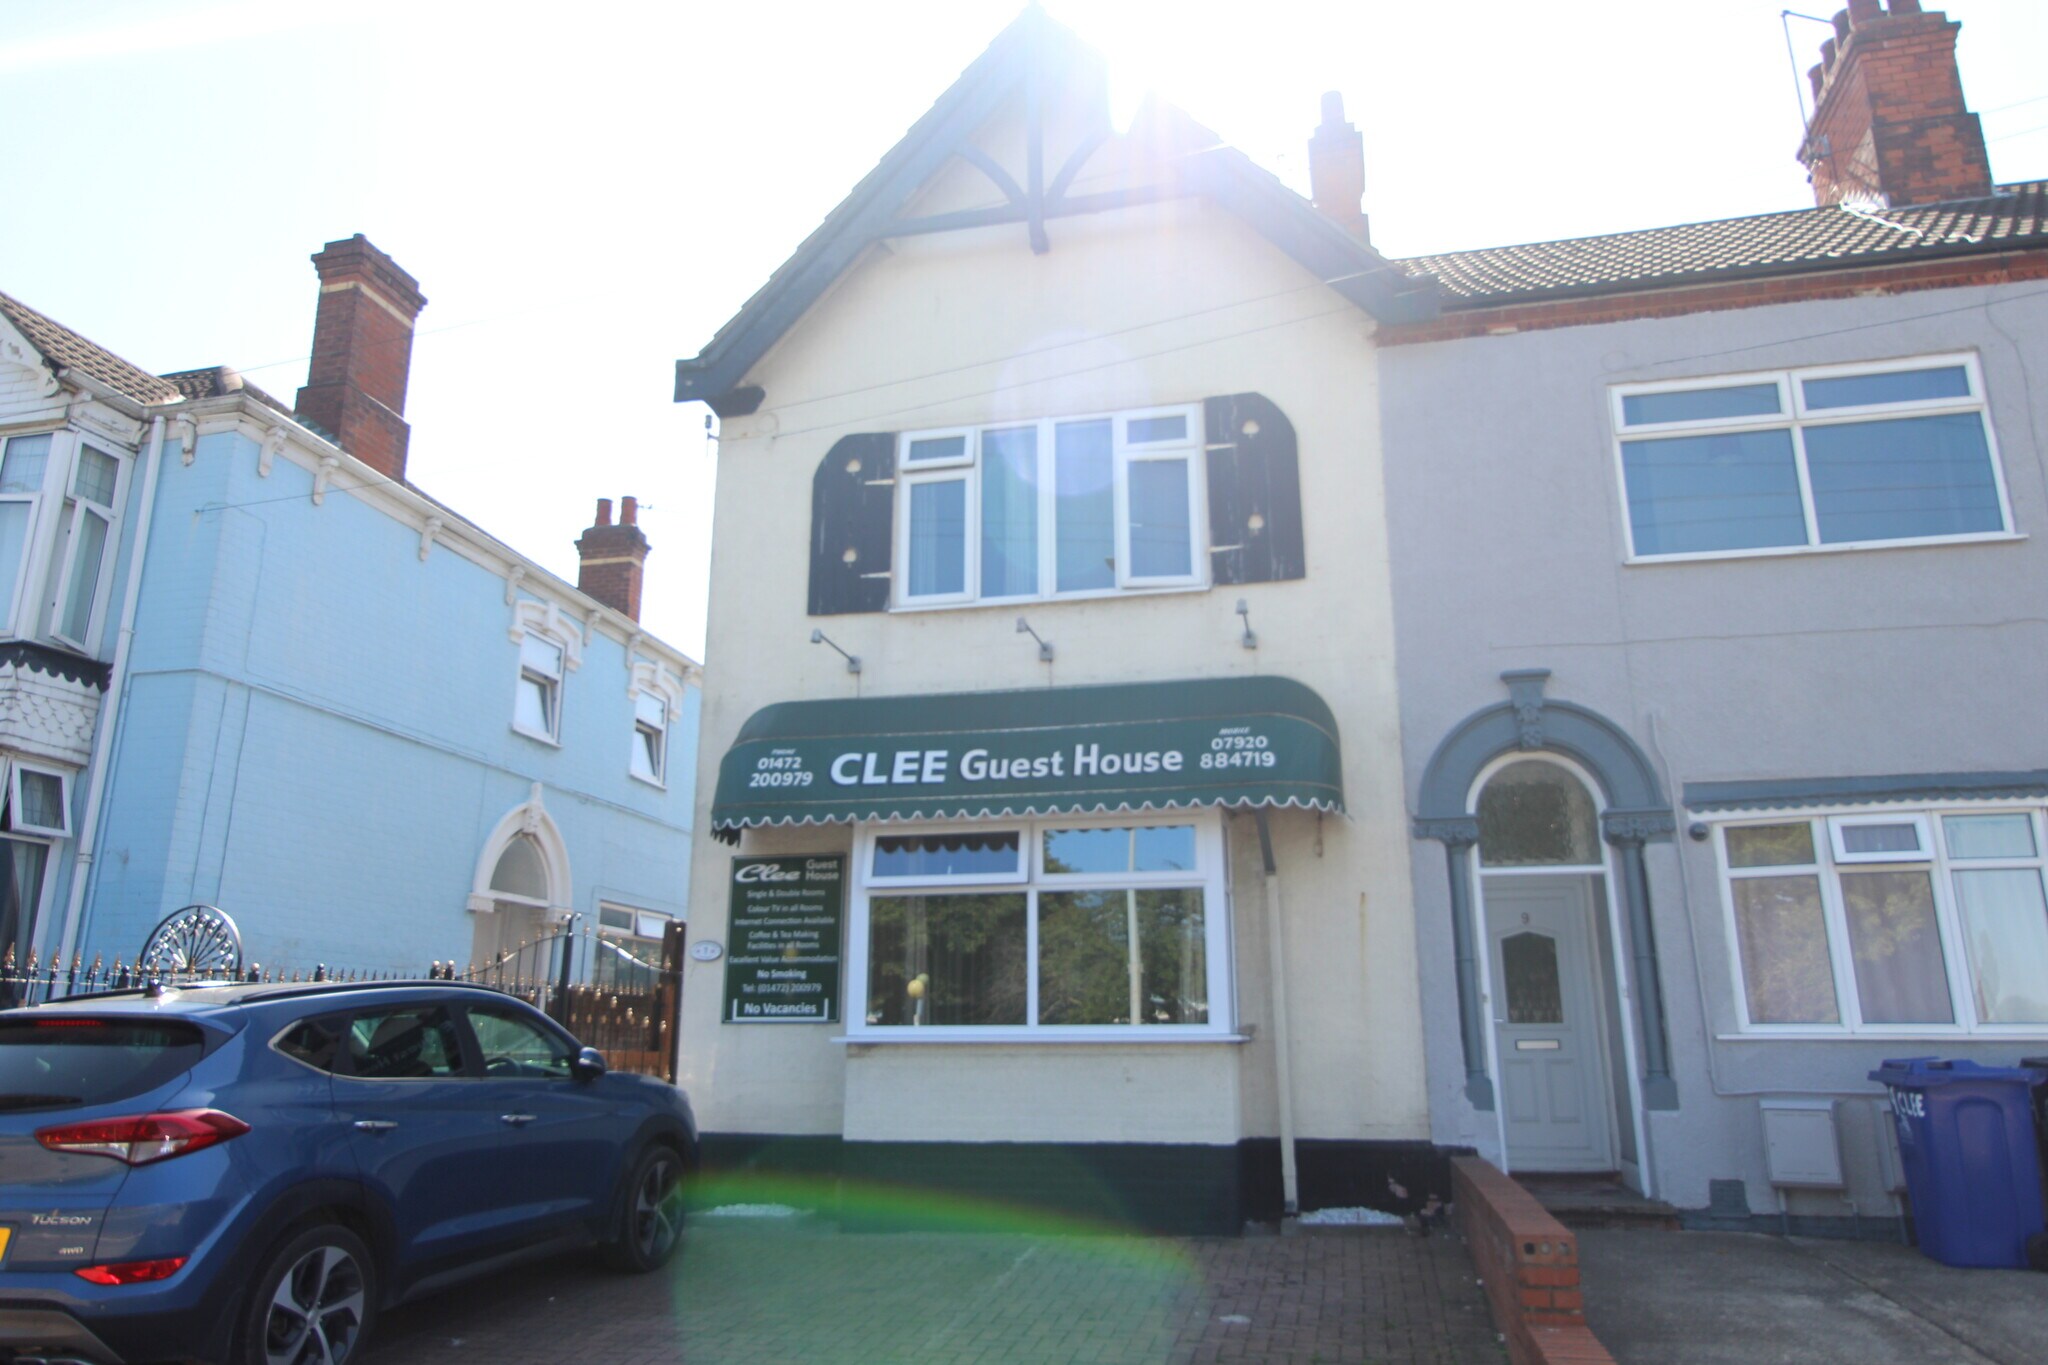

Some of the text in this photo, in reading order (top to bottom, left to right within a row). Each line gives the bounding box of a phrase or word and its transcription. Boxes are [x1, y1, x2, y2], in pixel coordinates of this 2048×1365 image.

[1211, 735, 1268, 750] 07920
[757, 756, 802, 770] 01472
[830, 743, 1183, 785] CLEE Guest House
[1199, 750, 1276, 769] 884719
[748, 771, 814, 788] 200979
[806, 859, 838, 869] Guest
[735, 863, 801, 883] Clee
[805, 870, 839, 880] House
[768, 889, 775, 897] &
[802, 888, 825, 897] Rooms
[747, 904, 770, 913] Colour
[771, 904, 781, 912] TV
[800, 903, 824, 911] Rooms
[735, 915, 835, 926] Internet Connection Available
[1521, 911, 1530, 925] 9
[772, 930, 779, 939] &
[792, 929, 819, 939] Making
[795, 940, 819, 949] Rooms
[757, 968, 807, 980] No Smoking
[791, 982, 822, 992] 200979
[744, 1001, 817, 1014] No Vacancies
[31, 1213, 92, 1225] TUCSON
[58, 1246, 84, 1255] 4WD
